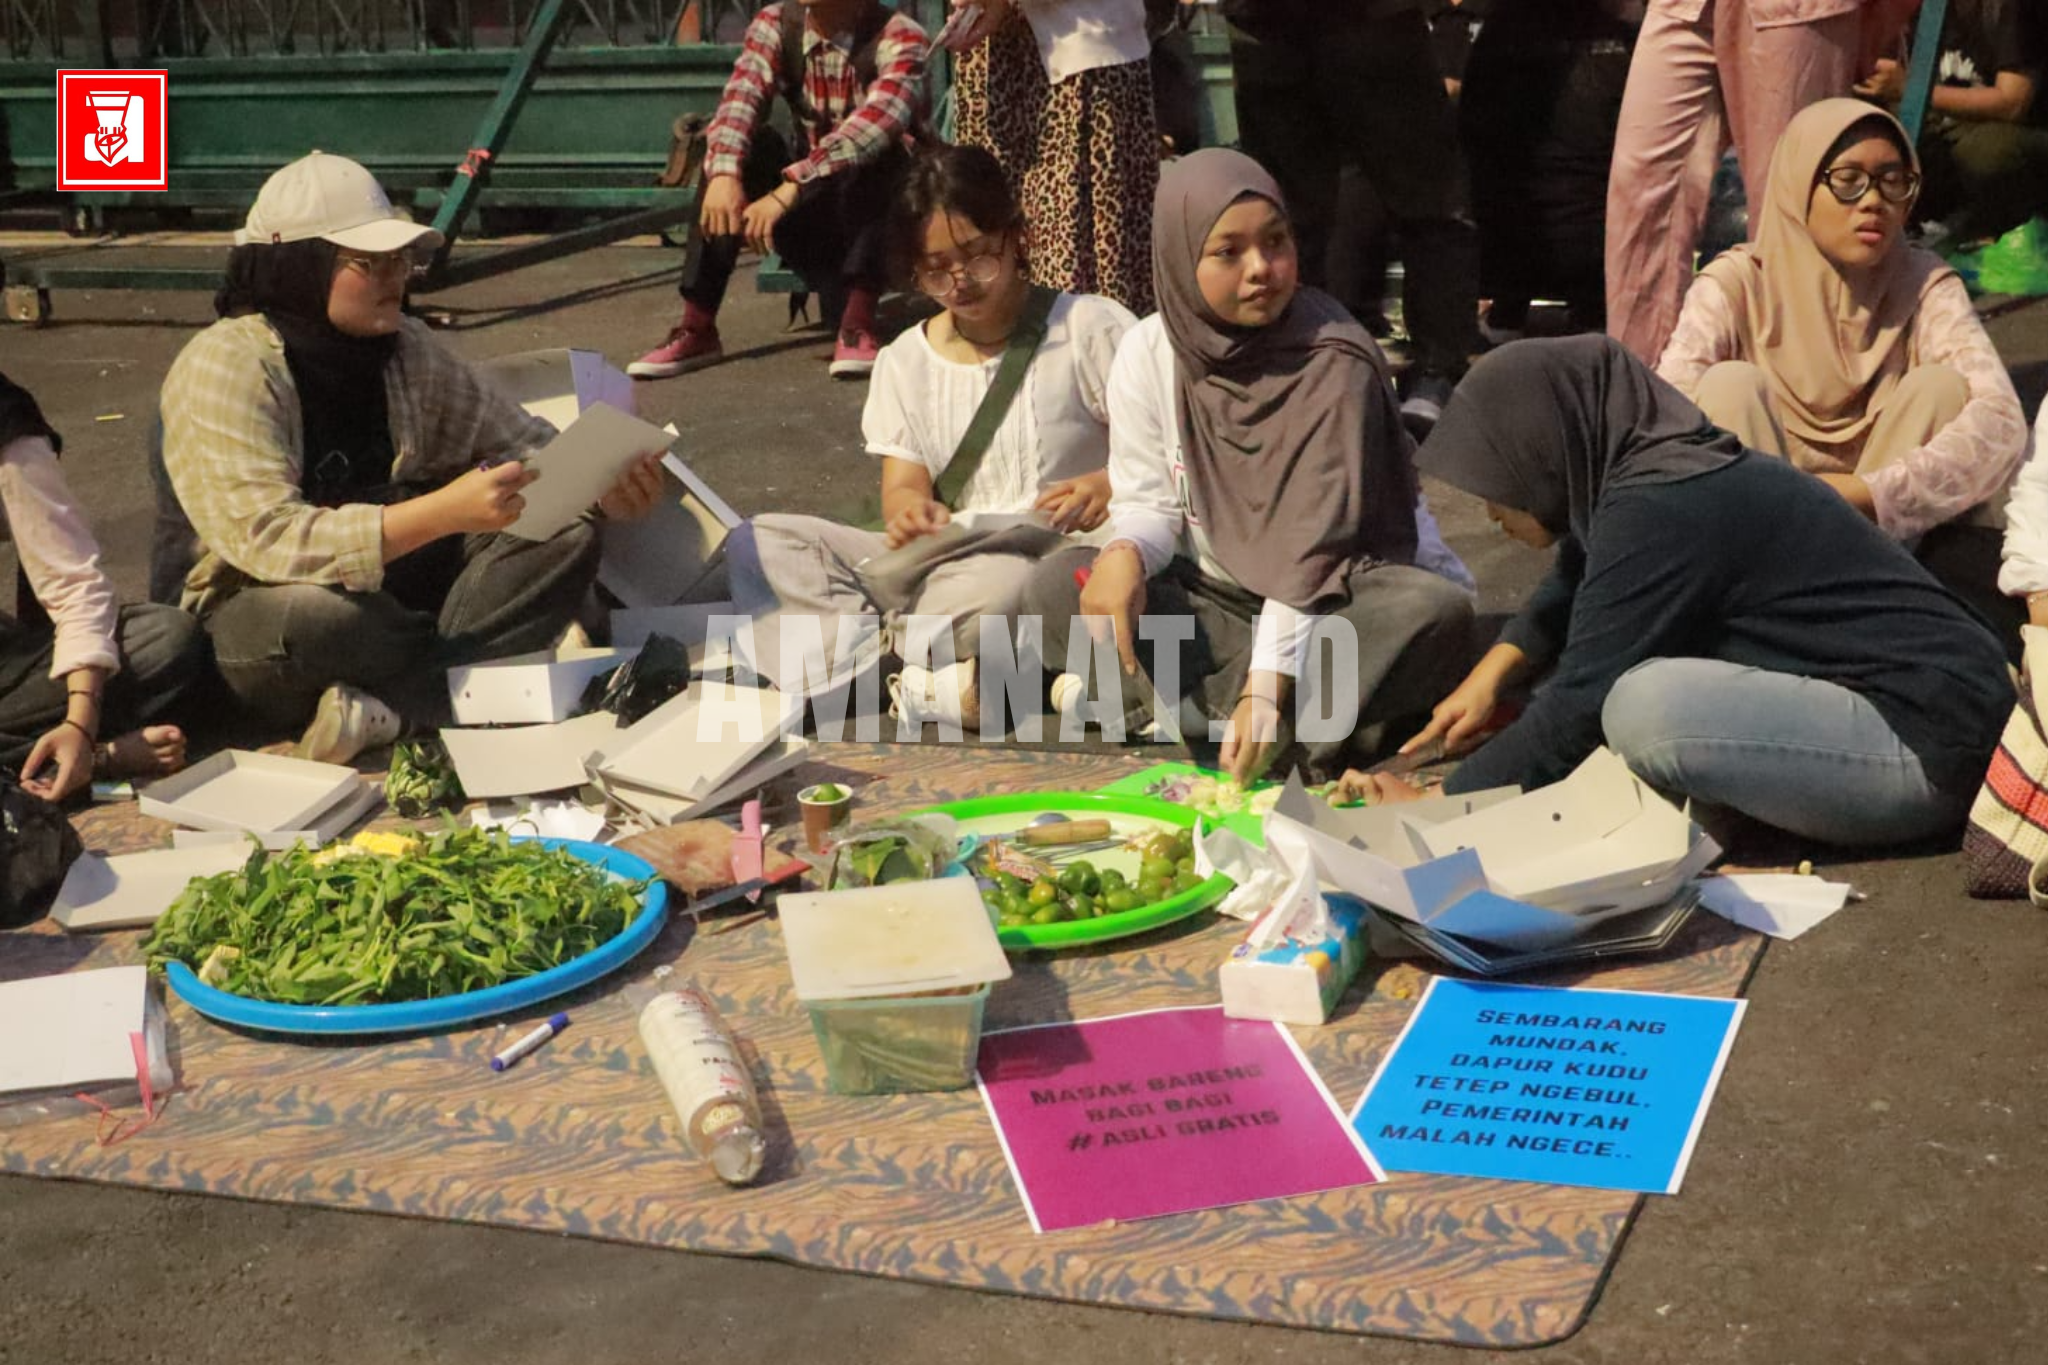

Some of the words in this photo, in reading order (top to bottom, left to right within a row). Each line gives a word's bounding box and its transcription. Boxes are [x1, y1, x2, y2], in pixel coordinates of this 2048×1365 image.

[1476, 1009, 1666, 1035] SEMBARANG
[1450, 1053, 1553, 1074] DAPUR
[1563, 1061, 1648, 1081] KUDU
[1030, 1082, 1137, 1105] MASAK
[1415, 1074, 1509, 1094] TETEP
[1086, 1103, 1155, 1122] BAGI
[1165, 1092, 1234, 1112] BAGI
[1420, 1099, 1630, 1131] PEMERINTAH
[1177, 1110, 1280, 1136] GRATIS
[1379, 1124, 1495, 1147] MALAH
